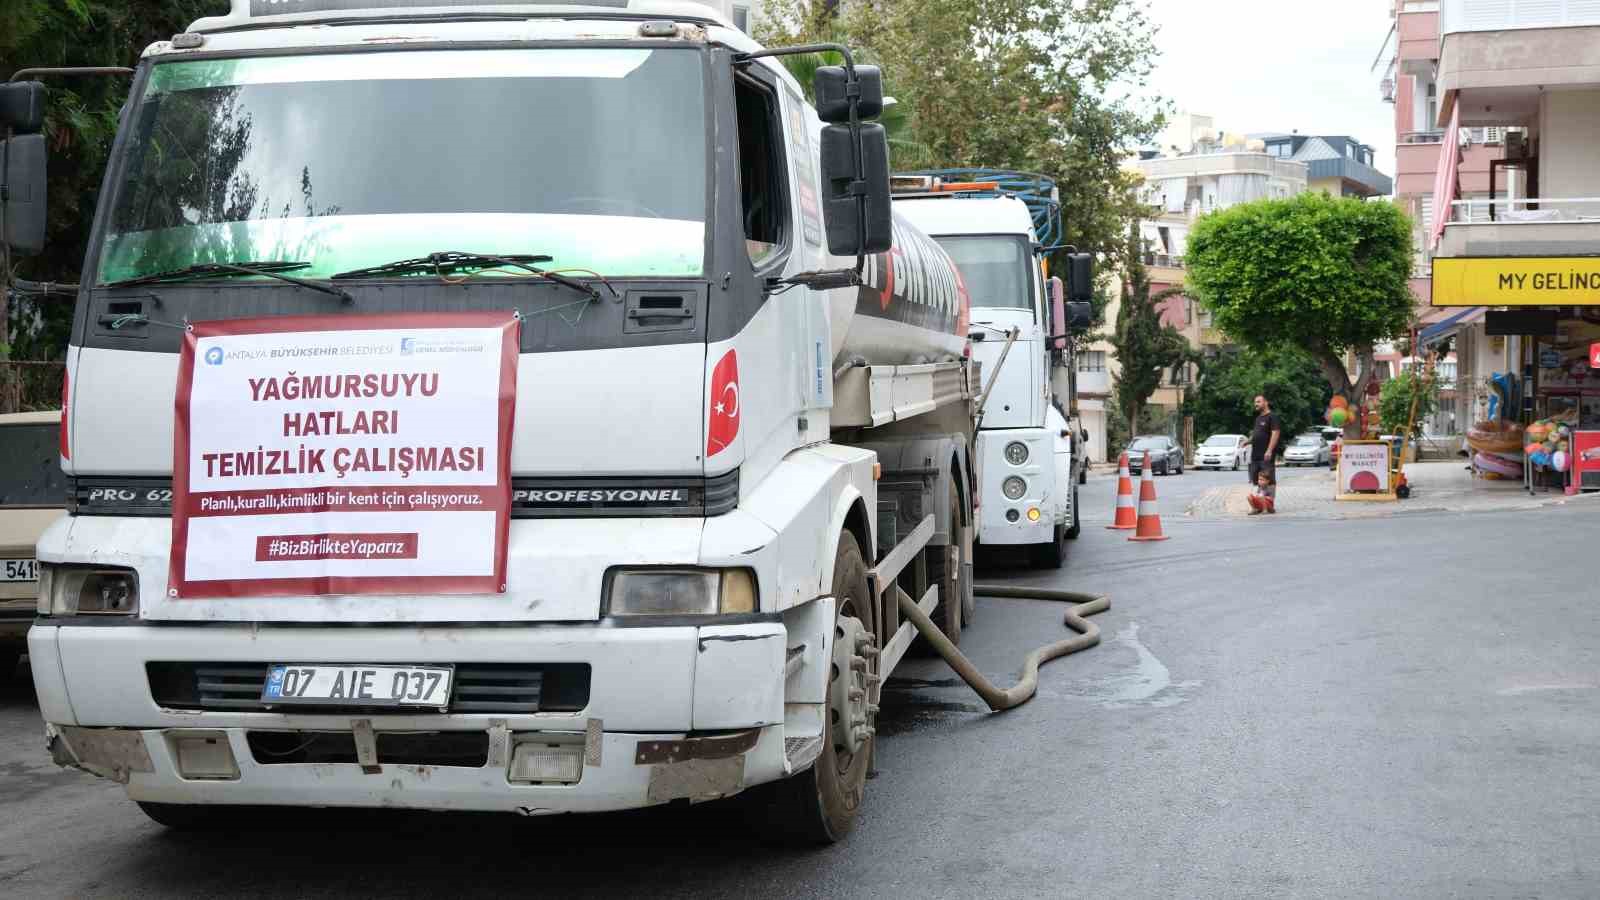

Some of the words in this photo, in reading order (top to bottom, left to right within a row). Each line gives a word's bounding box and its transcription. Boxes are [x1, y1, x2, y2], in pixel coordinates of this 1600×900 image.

[1499, 272, 1527, 289] MY
[225, 350, 267, 361] ANTALYA
[248, 371, 439, 401] YAĞMURSUYU
[283, 410, 398, 437] HATLARI
[202, 444, 326, 478] TEMİZLİK
[333, 446, 484, 479] ÇALIŞMASI
[90, 489, 136, 501] PRO
[326, 491, 346, 505] bir
[348, 491, 379, 505] kent
[382, 491, 405, 510] için
[408, 490, 483, 509] çalışıyoruz.
[513, 489, 682, 502] PROFESYONEL
[269, 537, 404, 557] #BizBirlikteYaparız
[282, 669, 317, 697] 07
[329, 670, 377, 699] AIE
[391, 671, 442, 701] 037
